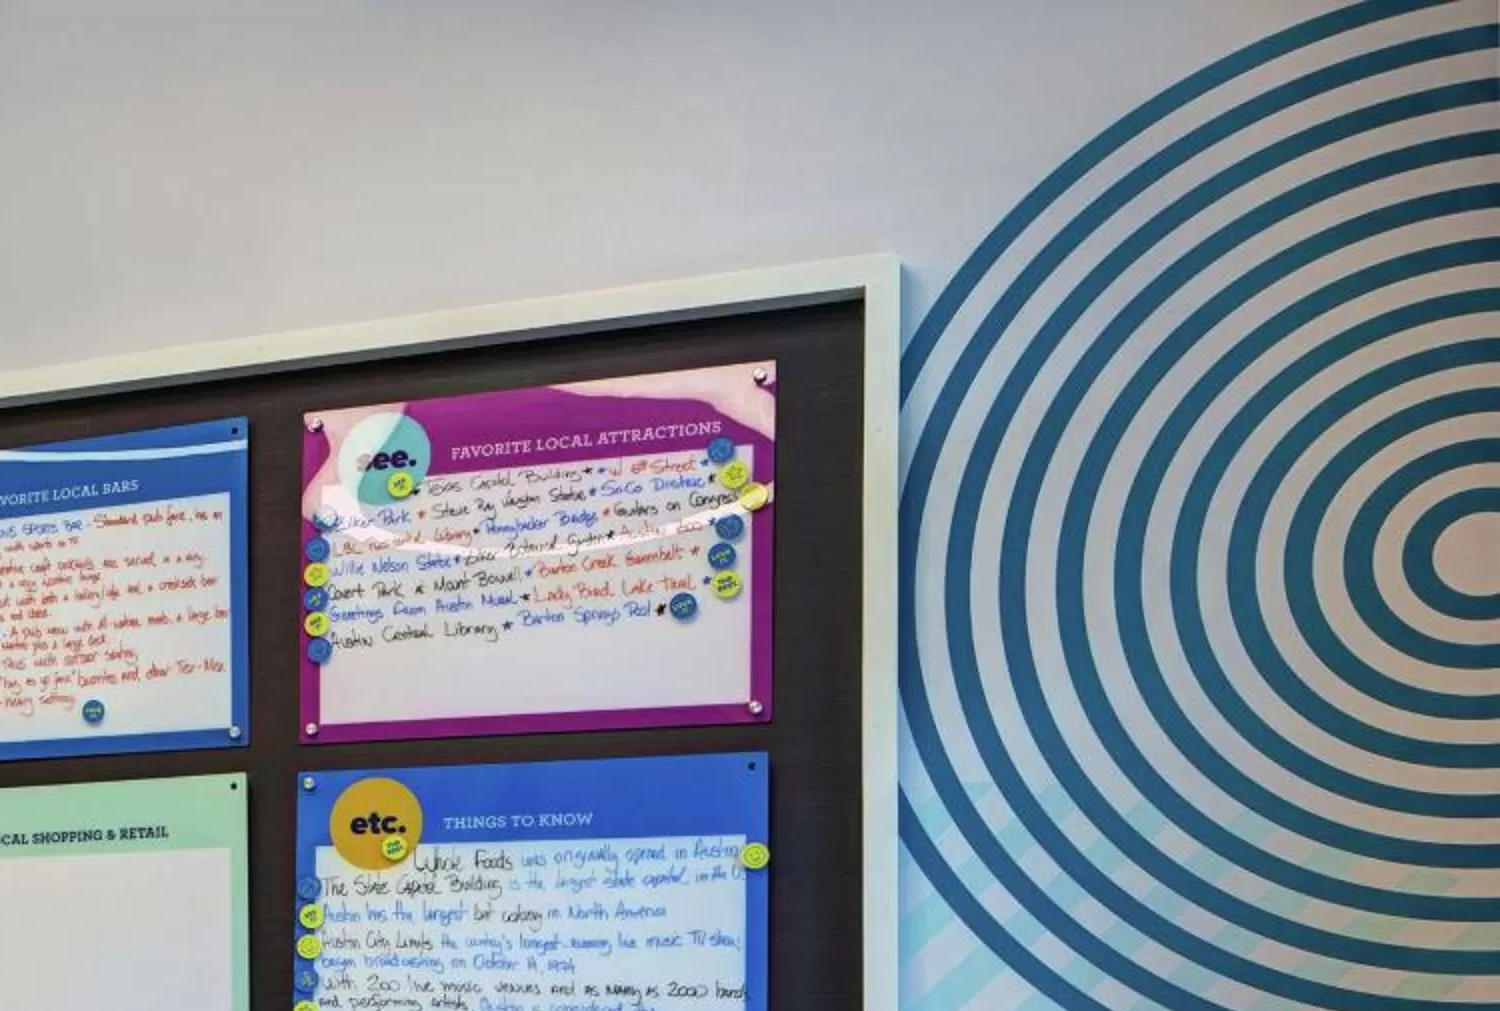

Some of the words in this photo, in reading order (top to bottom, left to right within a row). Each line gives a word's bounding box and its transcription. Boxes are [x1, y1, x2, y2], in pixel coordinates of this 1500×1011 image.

[452, 438, 531, 460] FAVORITE
[537, 434, 593, 451] LOCAL
[598, 421, 722, 444] ATTRACTIONS
[357, 449, 417, 472] see.
[53, 485, 99, 501] LOCAL
[102, 479, 140, 495] BARS
[443, 621, 499, 643] Library
[349, 812, 407, 834] etc.
[443, 814, 506, 830] THINGS
[510, 813, 535, 828] TO
[538, 811, 594, 827] KNOW
[32, 829, 103, 845] SHOPPING
[106, 829, 117, 841] &
[119, 826, 169, 841] RETAIL
[473, 849, 513, 870] Foods
[675, 845, 688, 860] in
[366, 974, 401, 991] 200
[666, 981, 710, 999] 2000
